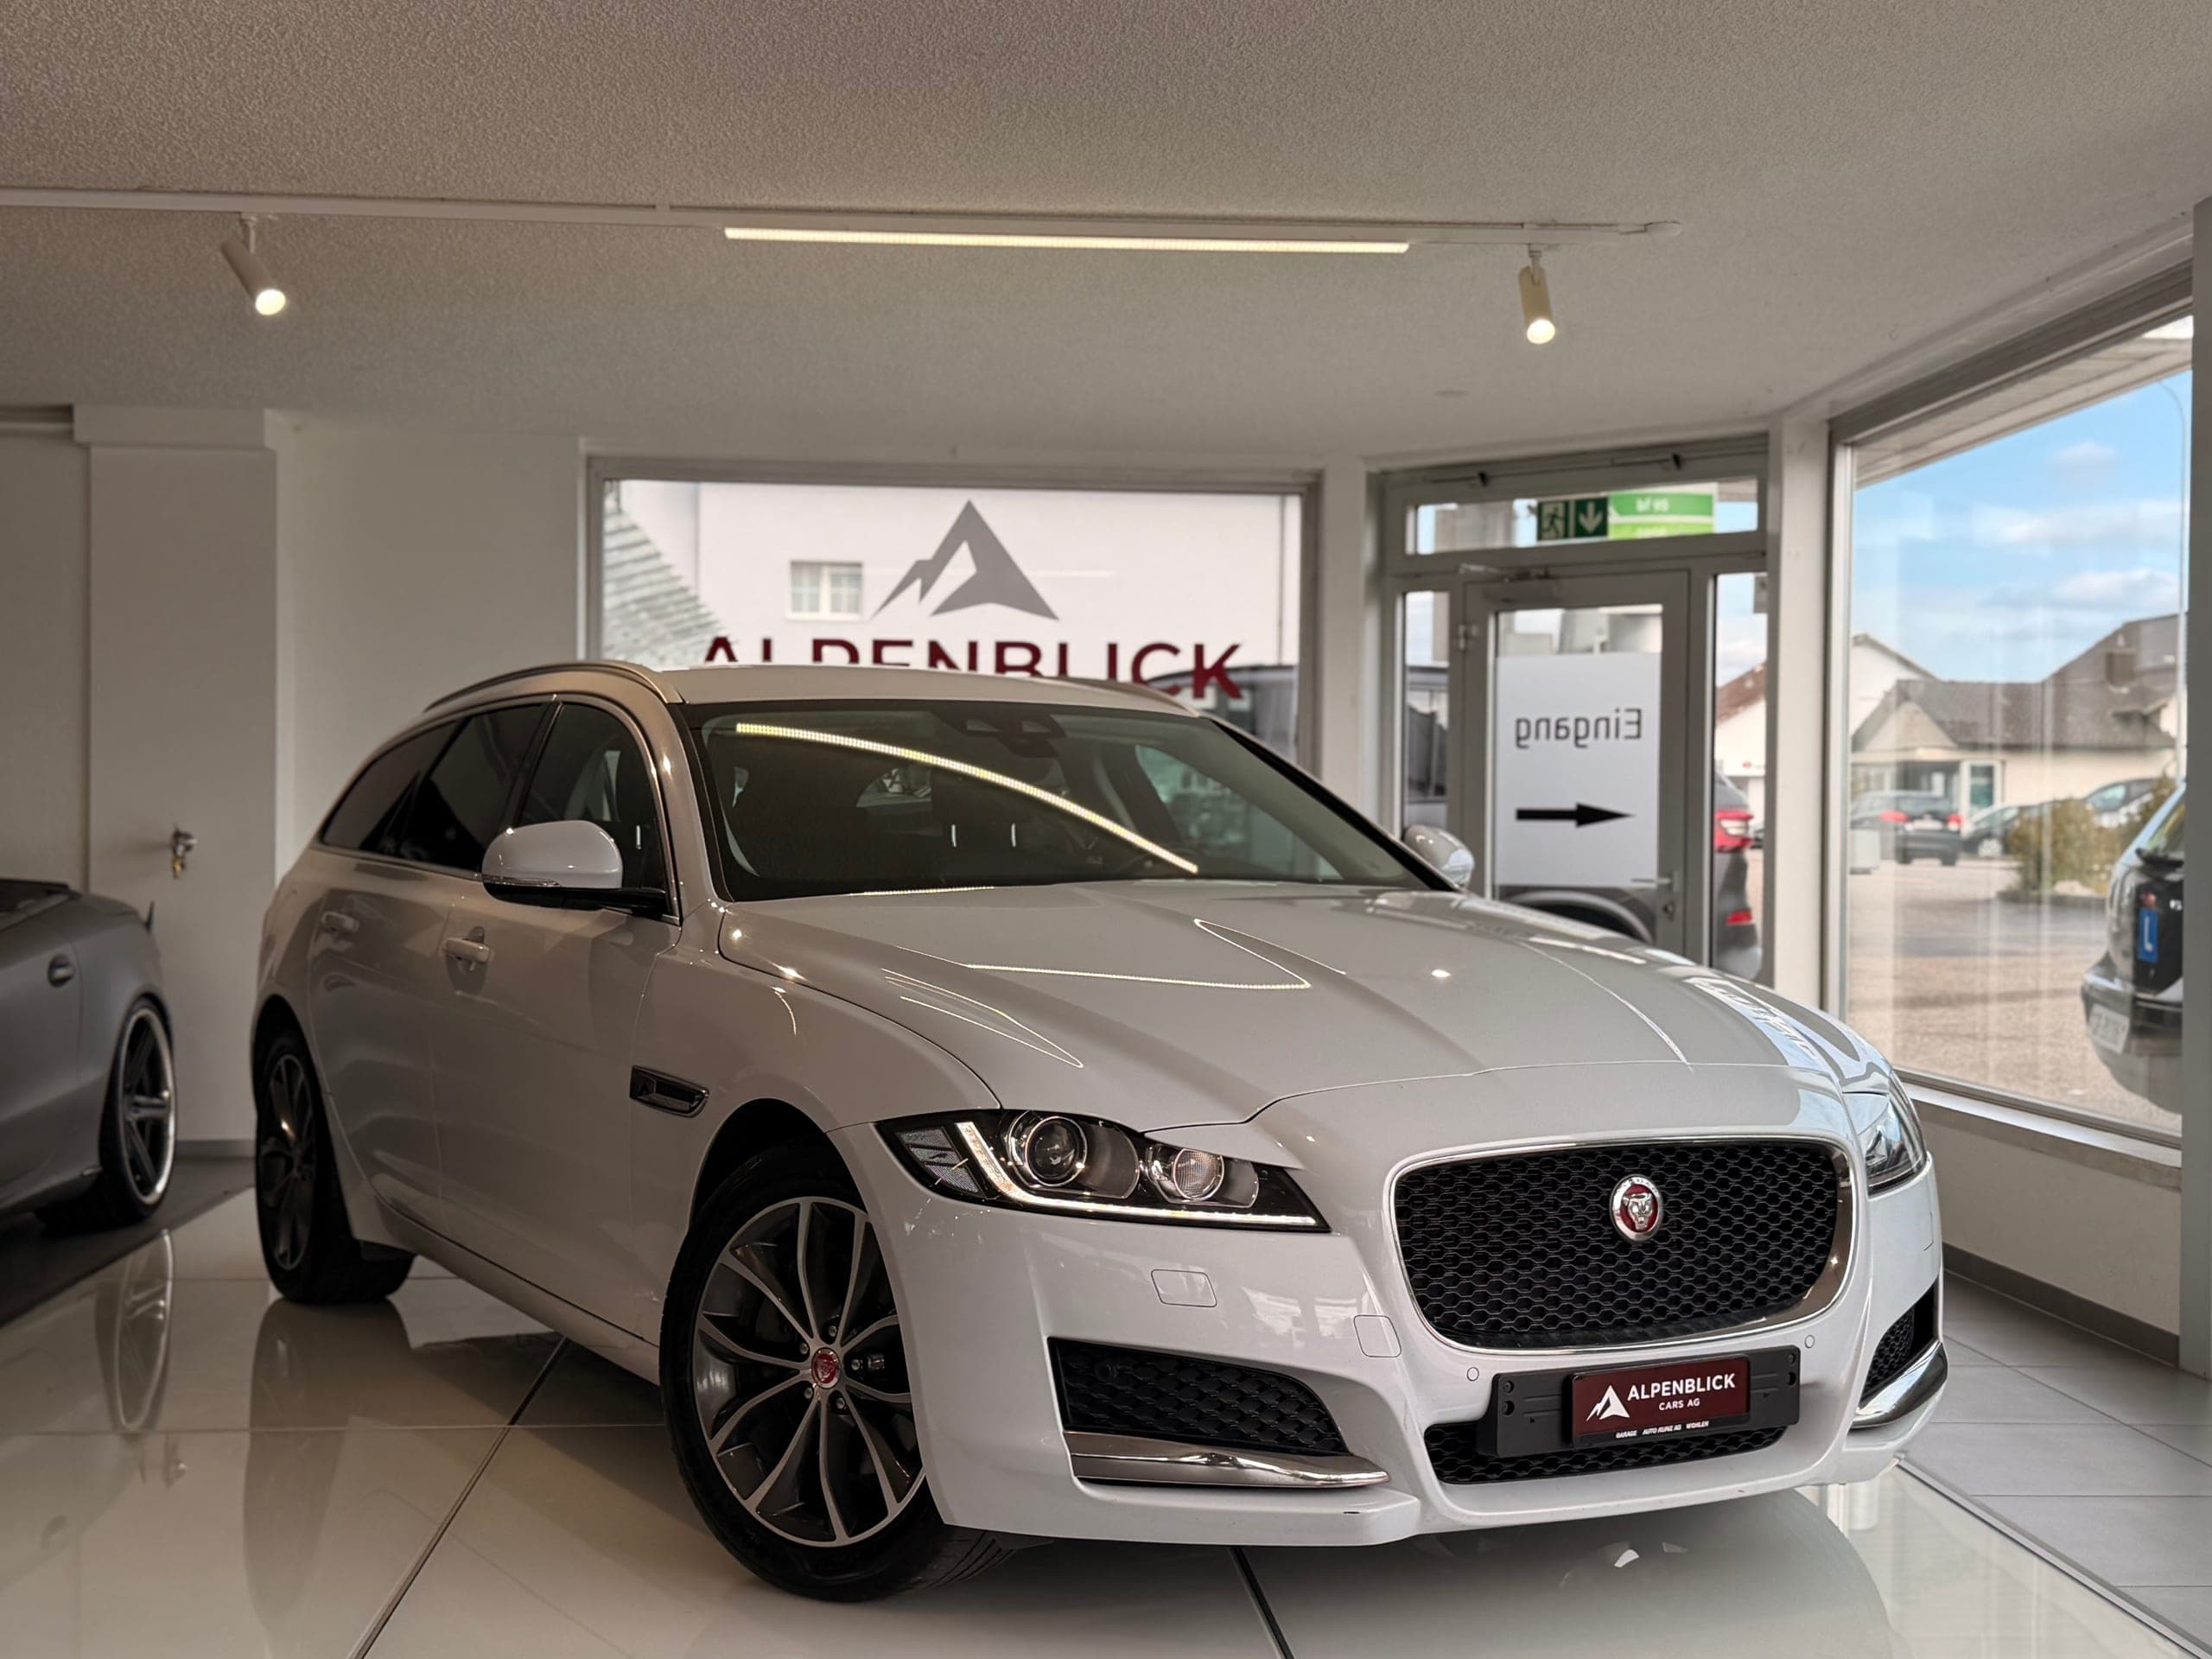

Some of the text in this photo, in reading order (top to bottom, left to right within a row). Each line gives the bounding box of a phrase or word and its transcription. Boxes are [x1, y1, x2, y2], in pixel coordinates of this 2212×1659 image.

[1627, 1373, 1736, 1402] ALPENBLICK
[1658, 1397, 1700, 1411] CARS AG
